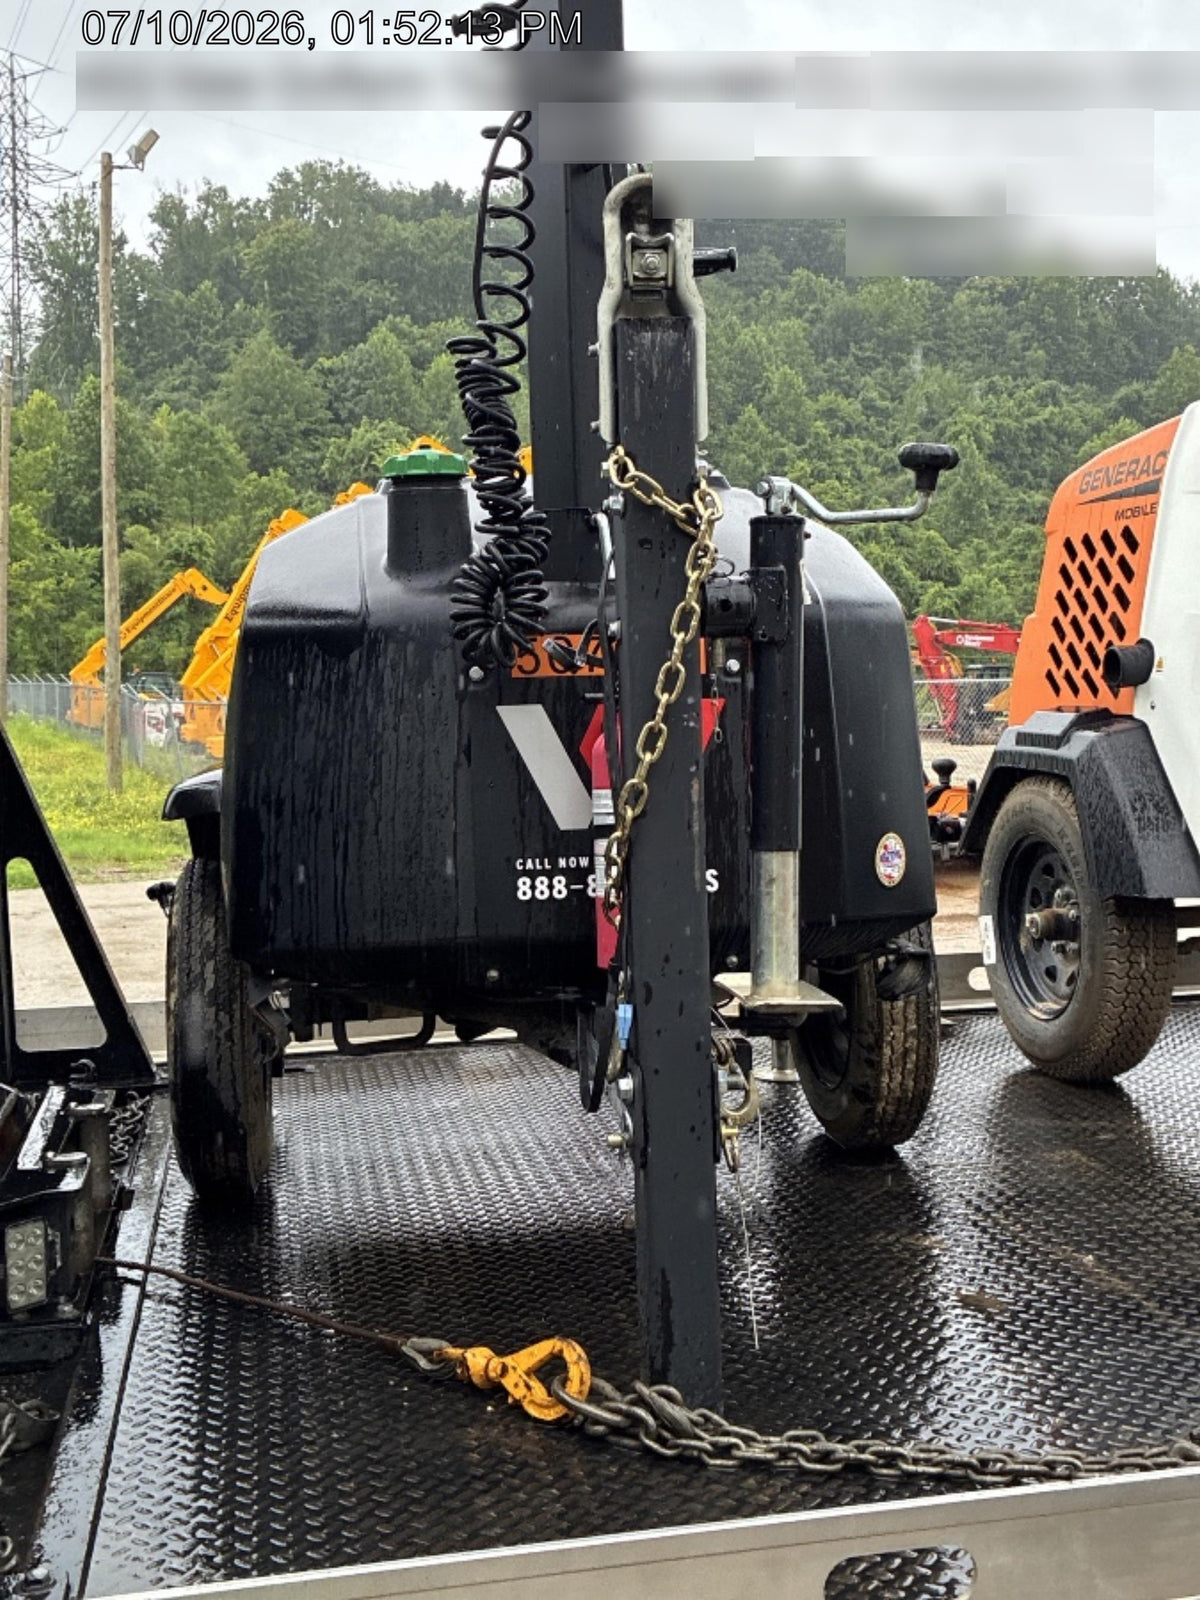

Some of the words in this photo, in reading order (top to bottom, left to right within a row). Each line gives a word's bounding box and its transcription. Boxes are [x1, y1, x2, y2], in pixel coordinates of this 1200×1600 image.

[1079, 449, 1168, 494] GENERAC
[1115, 502, 1157, 521] MOBILE
[515, 858, 552, 870] CALL
[558, 856, 589, 868] NOW
